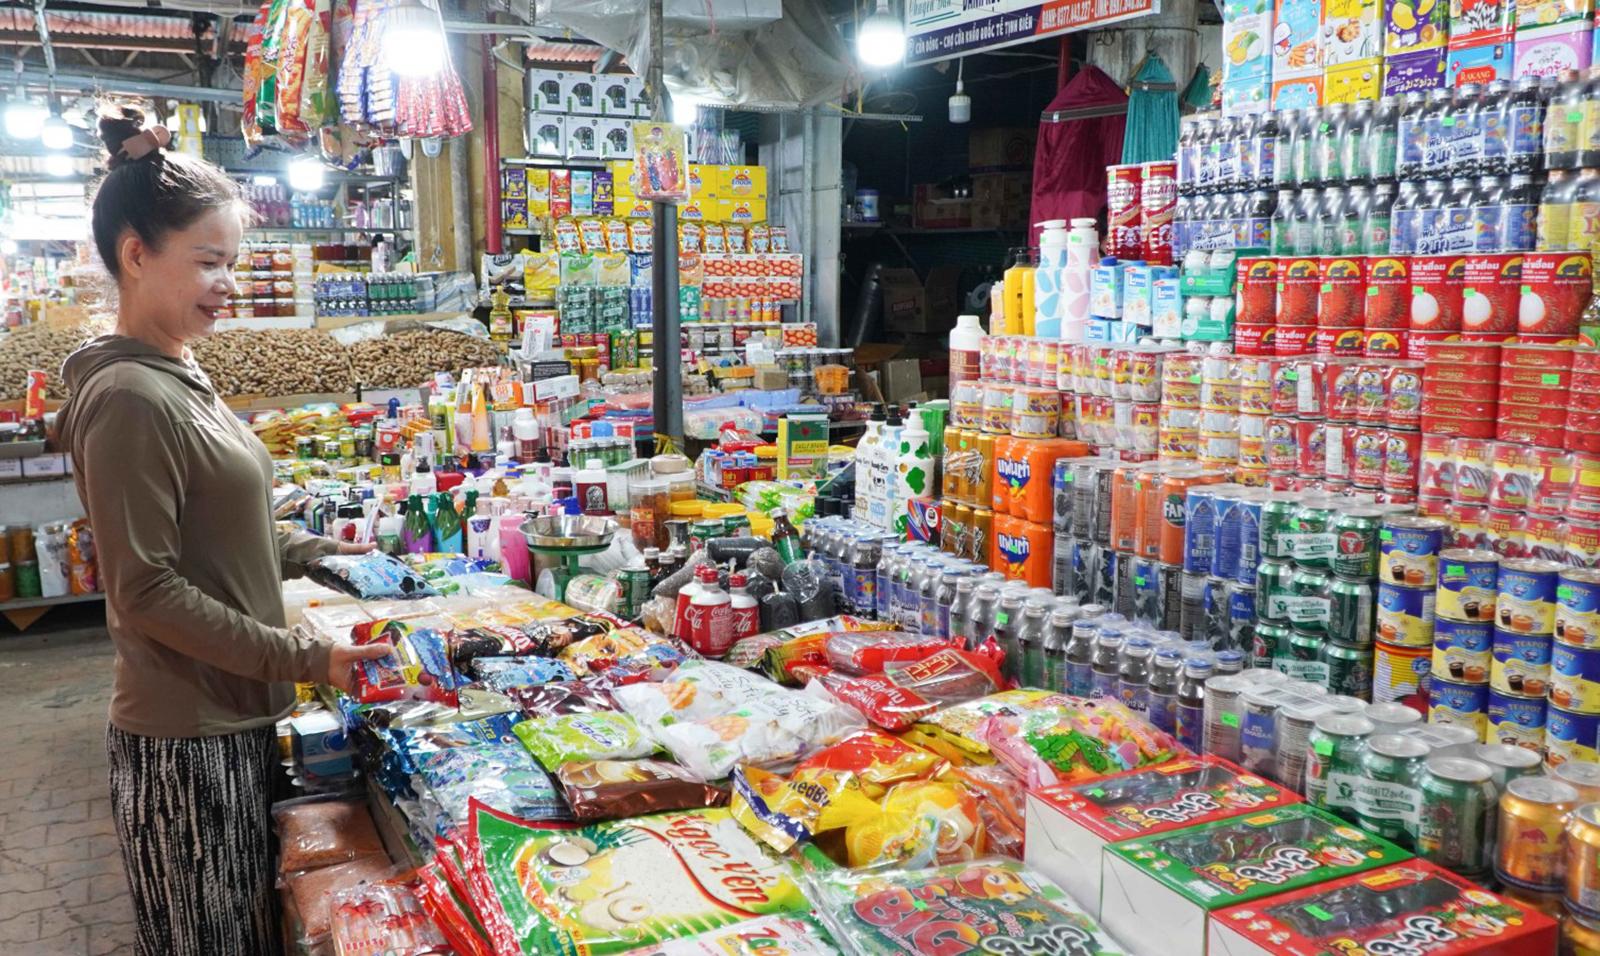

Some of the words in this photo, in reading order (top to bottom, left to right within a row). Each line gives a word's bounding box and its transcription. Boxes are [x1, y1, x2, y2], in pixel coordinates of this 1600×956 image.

[1397, 532, 1430, 541] TEAPOT
[1504, 575, 1538, 586] TEAPOT
[1455, 629, 1488, 637] TEAPOT
[1515, 640, 1549, 649] TEAPOT
[1442, 687, 1475, 697] TEAPOT
[1508, 703, 1542, 713] TEAPOT
[853, 886, 981, 956] BIG
